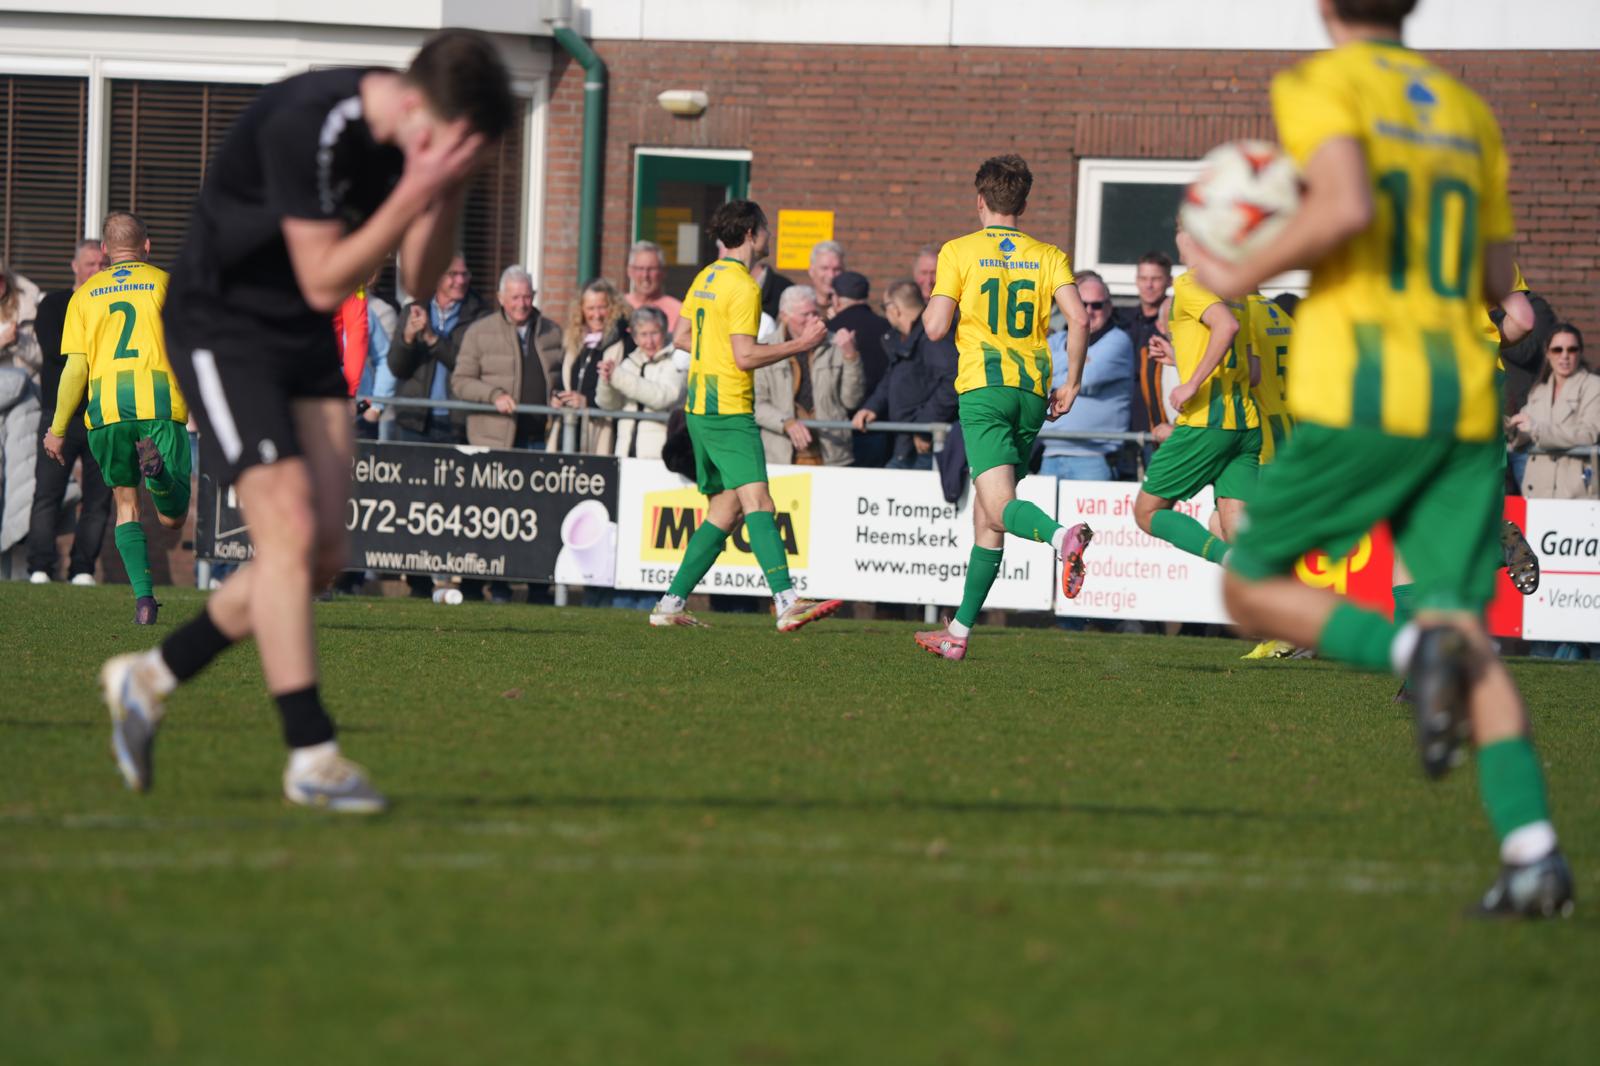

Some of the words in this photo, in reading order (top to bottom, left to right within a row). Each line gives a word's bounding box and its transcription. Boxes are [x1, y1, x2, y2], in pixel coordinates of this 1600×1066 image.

[1377, 169, 1479, 299] 10
[90, 283, 155, 298] VERZEKERINGEN
[981, 277, 1035, 339] 16
[109, 301, 139, 360] 2
[351, 455, 402, 484] elax
[434, 458, 465, 488] it's
[470, 461, 524, 492] Miko
[530, 465, 606, 496] coffee
[857, 497, 880, 516] De
[1076, 497, 1107, 515] van
[856, 525, 959, 548] Heemskerk
[1541, 531, 1600, 557] Gara
[365, 550, 505, 576] www.miko-koffie.nl
[1167, 563, 1188, 580] en
[714, 572, 808, 591] BADKARS
